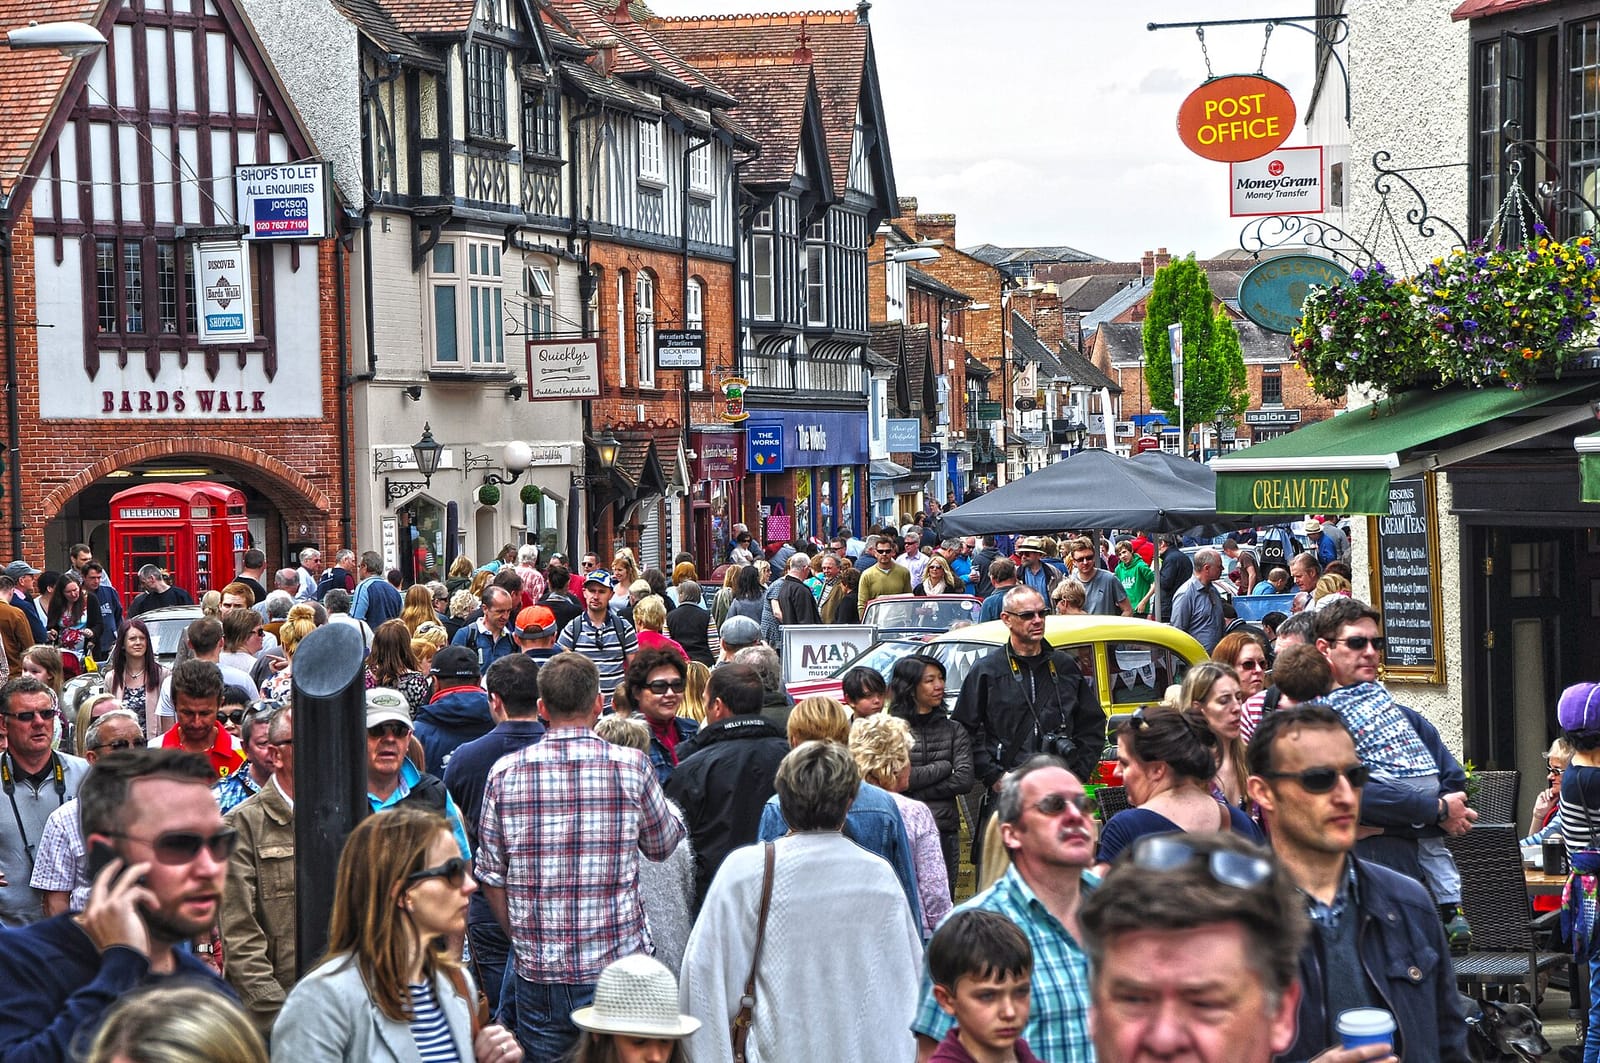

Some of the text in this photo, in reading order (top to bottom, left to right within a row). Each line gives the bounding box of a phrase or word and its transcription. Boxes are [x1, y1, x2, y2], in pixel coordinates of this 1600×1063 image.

[1204, 93, 1266, 120] POST
[1197, 116, 1280, 145] OFFICE
[240, 166, 318, 181] SHOPS TO LET
[246, 183, 315, 195] ALL ENQUIRIES
[1236, 175, 1318, 191] MoneyGram
[1245, 188, 1309, 201] Money Transfer
[271, 199, 307, 212] jackson
[284, 208, 307, 217] criss
[256, 220, 307, 230] 020 7637 7100
[207, 260, 236, 270] DISCOVER
[1253, 261, 1342, 288] HOBSONS
[207, 287, 240, 299] Bards Walk
[209, 316, 241, 328] SHOPPING
[538, 346, 590, 366] Quicklys
[535, 387, 562, 396] Traditional
[102, 389, 266, 413] BARDS WALK
[1251, 412, 1286, 421] salön
[796, 423, 809, 451] The
[1253, 477, 1349, 510] CREAM TEAS
[1389, 488, 1415, 500] OBSONS
[122, 508, 180, 517] TELEPHONE
[1379, 514, 1426, 536] CREAM TEAS
[724, 720, 742, 729] HELLY
